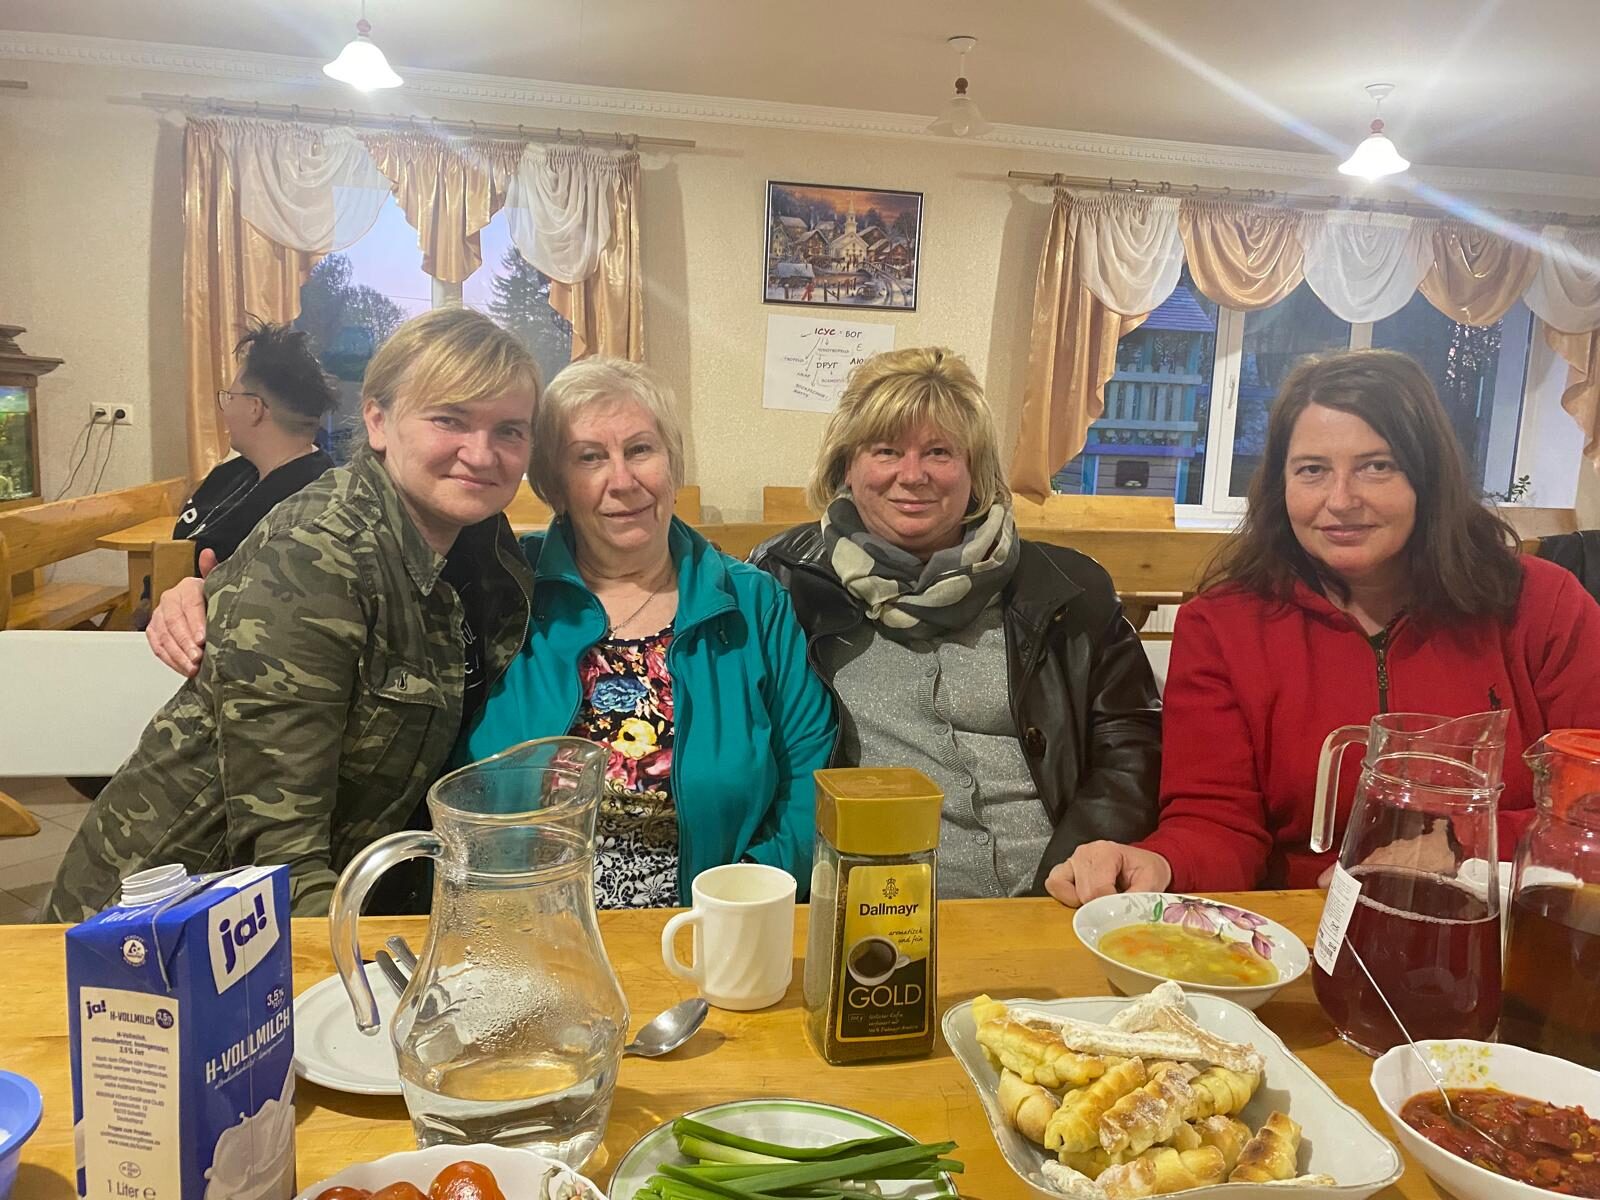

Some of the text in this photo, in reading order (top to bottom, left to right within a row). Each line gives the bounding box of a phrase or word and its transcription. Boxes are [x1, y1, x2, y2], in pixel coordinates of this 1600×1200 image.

[814, 327, 863, 339] ІСУС БОГ
[859, 903, 919, 917] Dallmayr
[219, 893, 267, 975] ja!
[848, 984, 922, 1009] GOLD
[86, 1000, 107, 1020] ja!
[110, 1011, 155, 1026] H-VOLLMILCH
[205, 1007, 291, 1085] H-VOLLMILCH
[107, 1179, 112, 1193] 1
[116, 1181, 140, 1198] Liter
